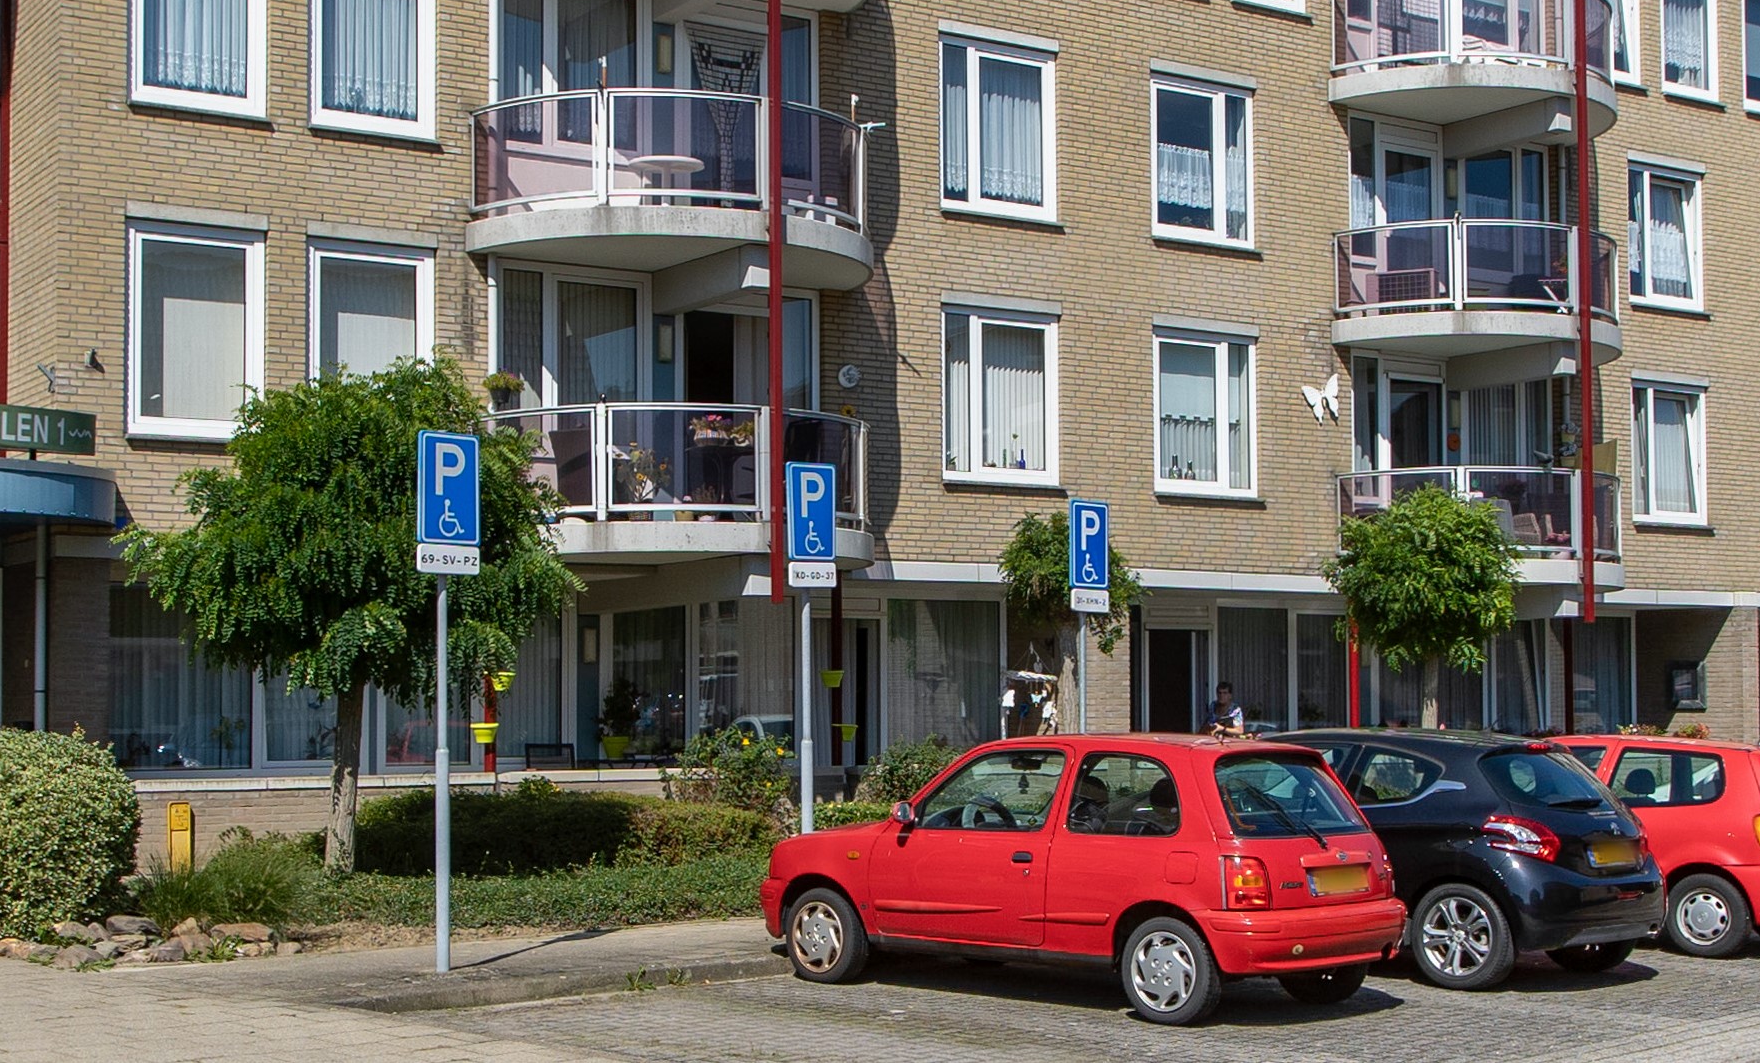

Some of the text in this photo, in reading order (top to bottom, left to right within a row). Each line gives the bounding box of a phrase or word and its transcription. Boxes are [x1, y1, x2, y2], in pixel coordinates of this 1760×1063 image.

[56, 417, 65, 445] 1
[435, 442, 466, 496] P
[800, 471, 825, 518] P
[1080, 509, 1101, 551] P
[421, 553, 478, 567] 69-SV-PZ
